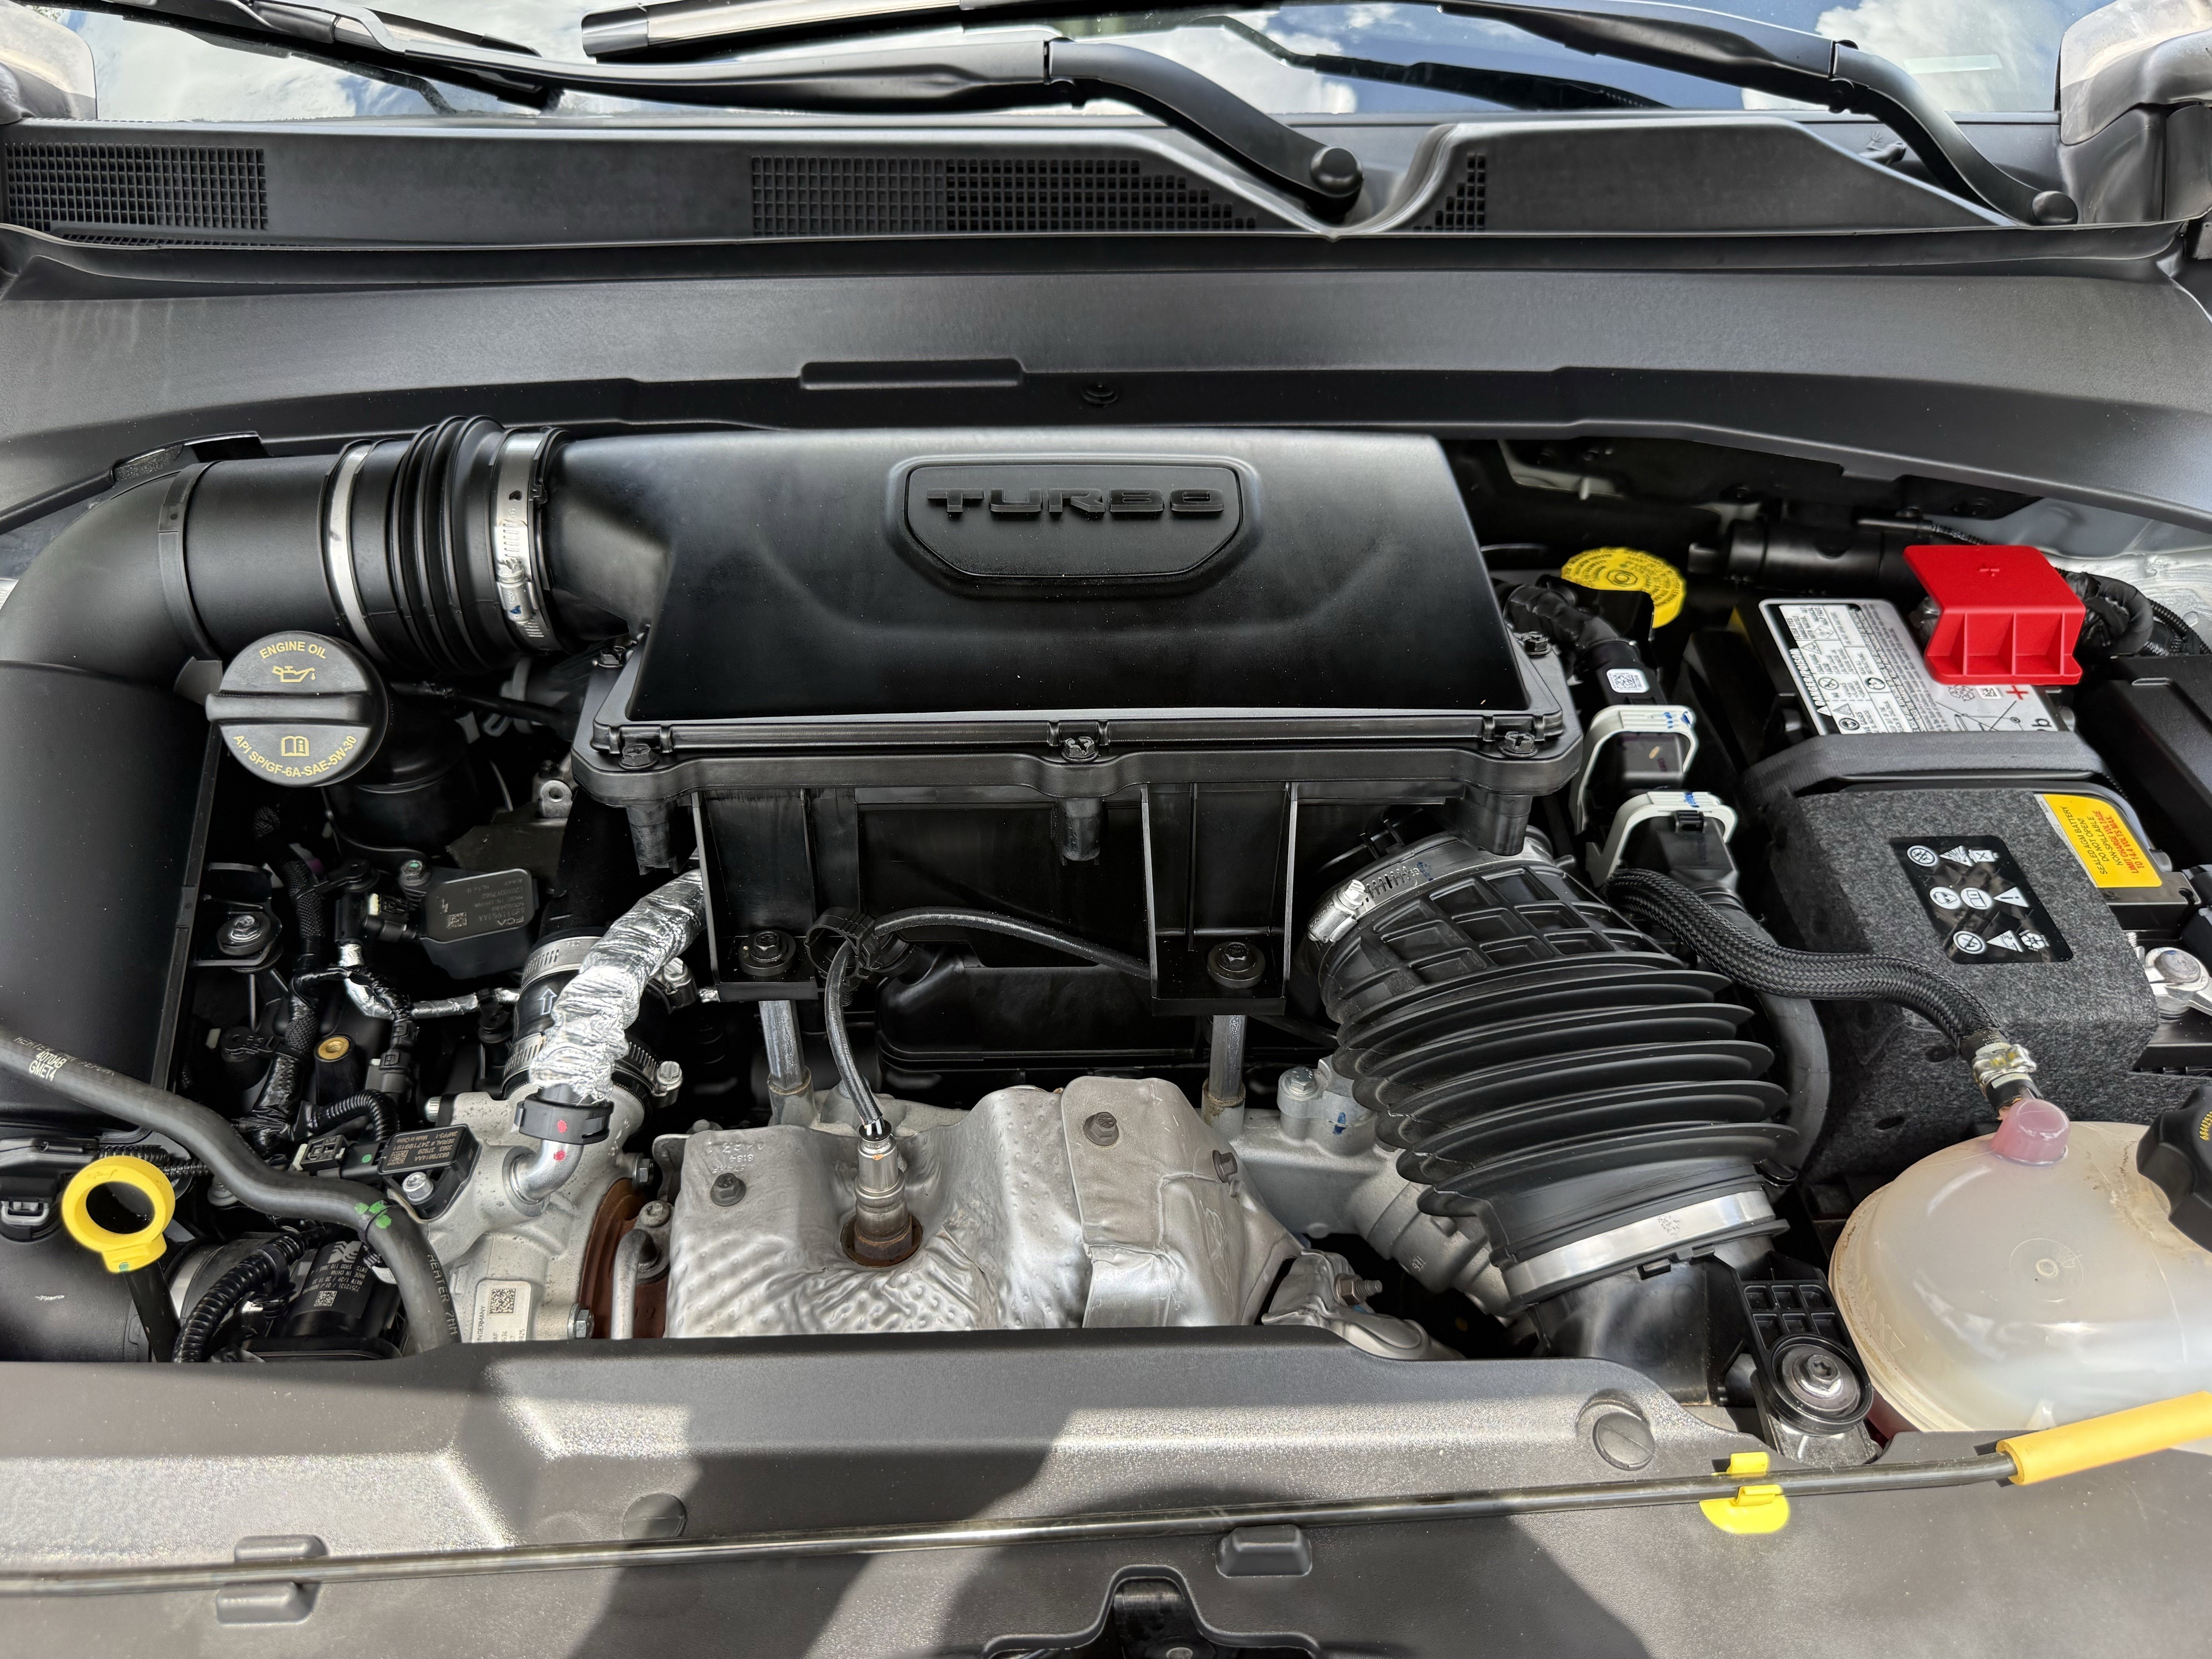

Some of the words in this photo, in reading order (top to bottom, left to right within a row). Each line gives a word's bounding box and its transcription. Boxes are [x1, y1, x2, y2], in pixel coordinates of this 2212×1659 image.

[927, 488, 1224, 513] TURBO
[259, 641, 305, 659] ENGINE
[307, 644, 327, 659] OIL
[1788, 648, 1827, 706] DANGER/POISON
[234, 734, 250, 754] API
[2059, 806, 2083, 832] BATTERY
[2075, 818, 2095, 836] OPEN!
[2092, 811, 2114, 834] VOLTAGE
[2085, 817, 2124, 865] NON-SPILLABLE
[2088, 839, 2103, 850] NOT
[2108, 836, 2129, 857] CHARGE
[2113, 830, 2131, 847] VOLTS
[2085, 850, 2109, 874] SEALED
[2097, 852, 2110, 861] DO
[2125, 848, 2139, 859] 14.4
[2123, 859, 2139, 873] LIMIT
[497, 916, 524, 926] FCA
[36, 1051, 67, 1069] 4070AB
[29, 1060, 57, 1082] GMET4
[393, 1141, 430, 1150] 247199191
[427, 1254, 450, 1303] HEATER
[478, 1305, 487, 1333] GERMANY
